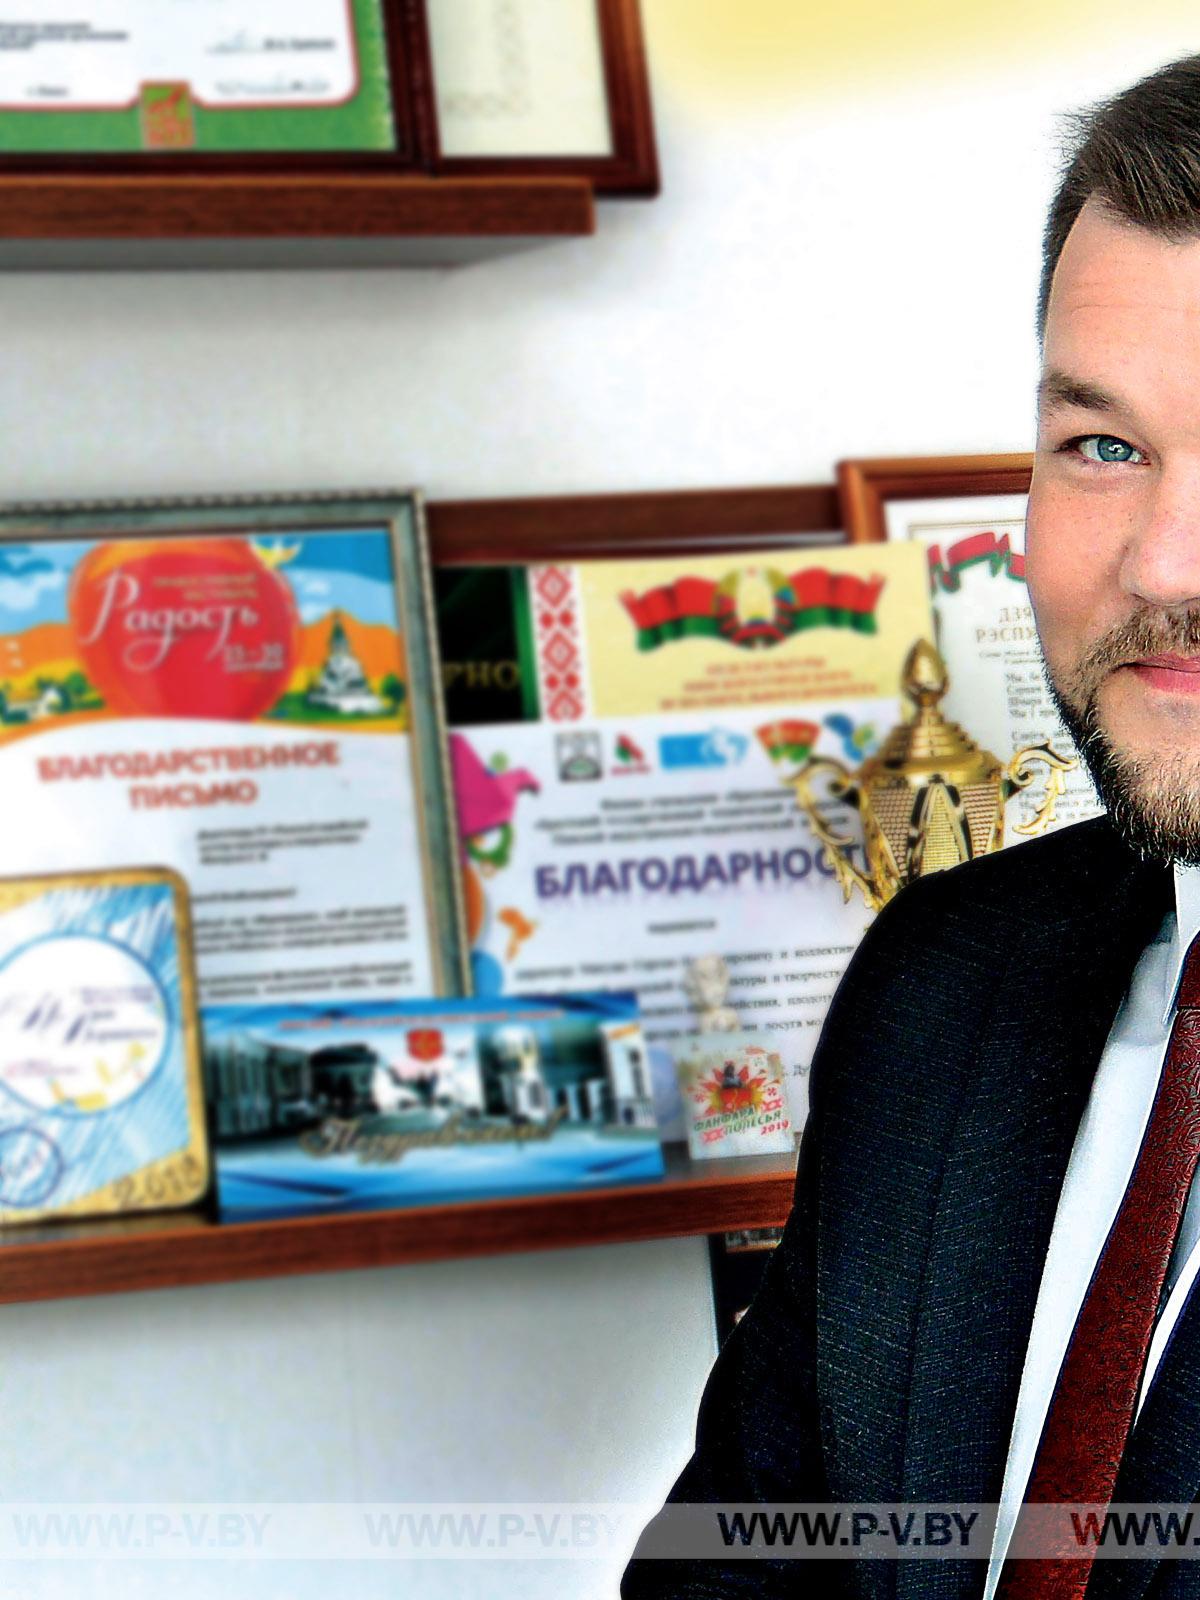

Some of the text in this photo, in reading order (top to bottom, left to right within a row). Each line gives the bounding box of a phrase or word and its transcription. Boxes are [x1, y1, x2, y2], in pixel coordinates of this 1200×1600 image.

[78, 567, 258, 672] Радость
[999, 606, 1033, 623] ДЗЯ
[976, 626, 1037, 642] РЭСПУ
[37, 741, 339, 783] БЛАГОДАРСТВЕННОЕ
[128, 778, 258, 810] ПИСЬМО
[785, 970, 841, 983] творчеств
